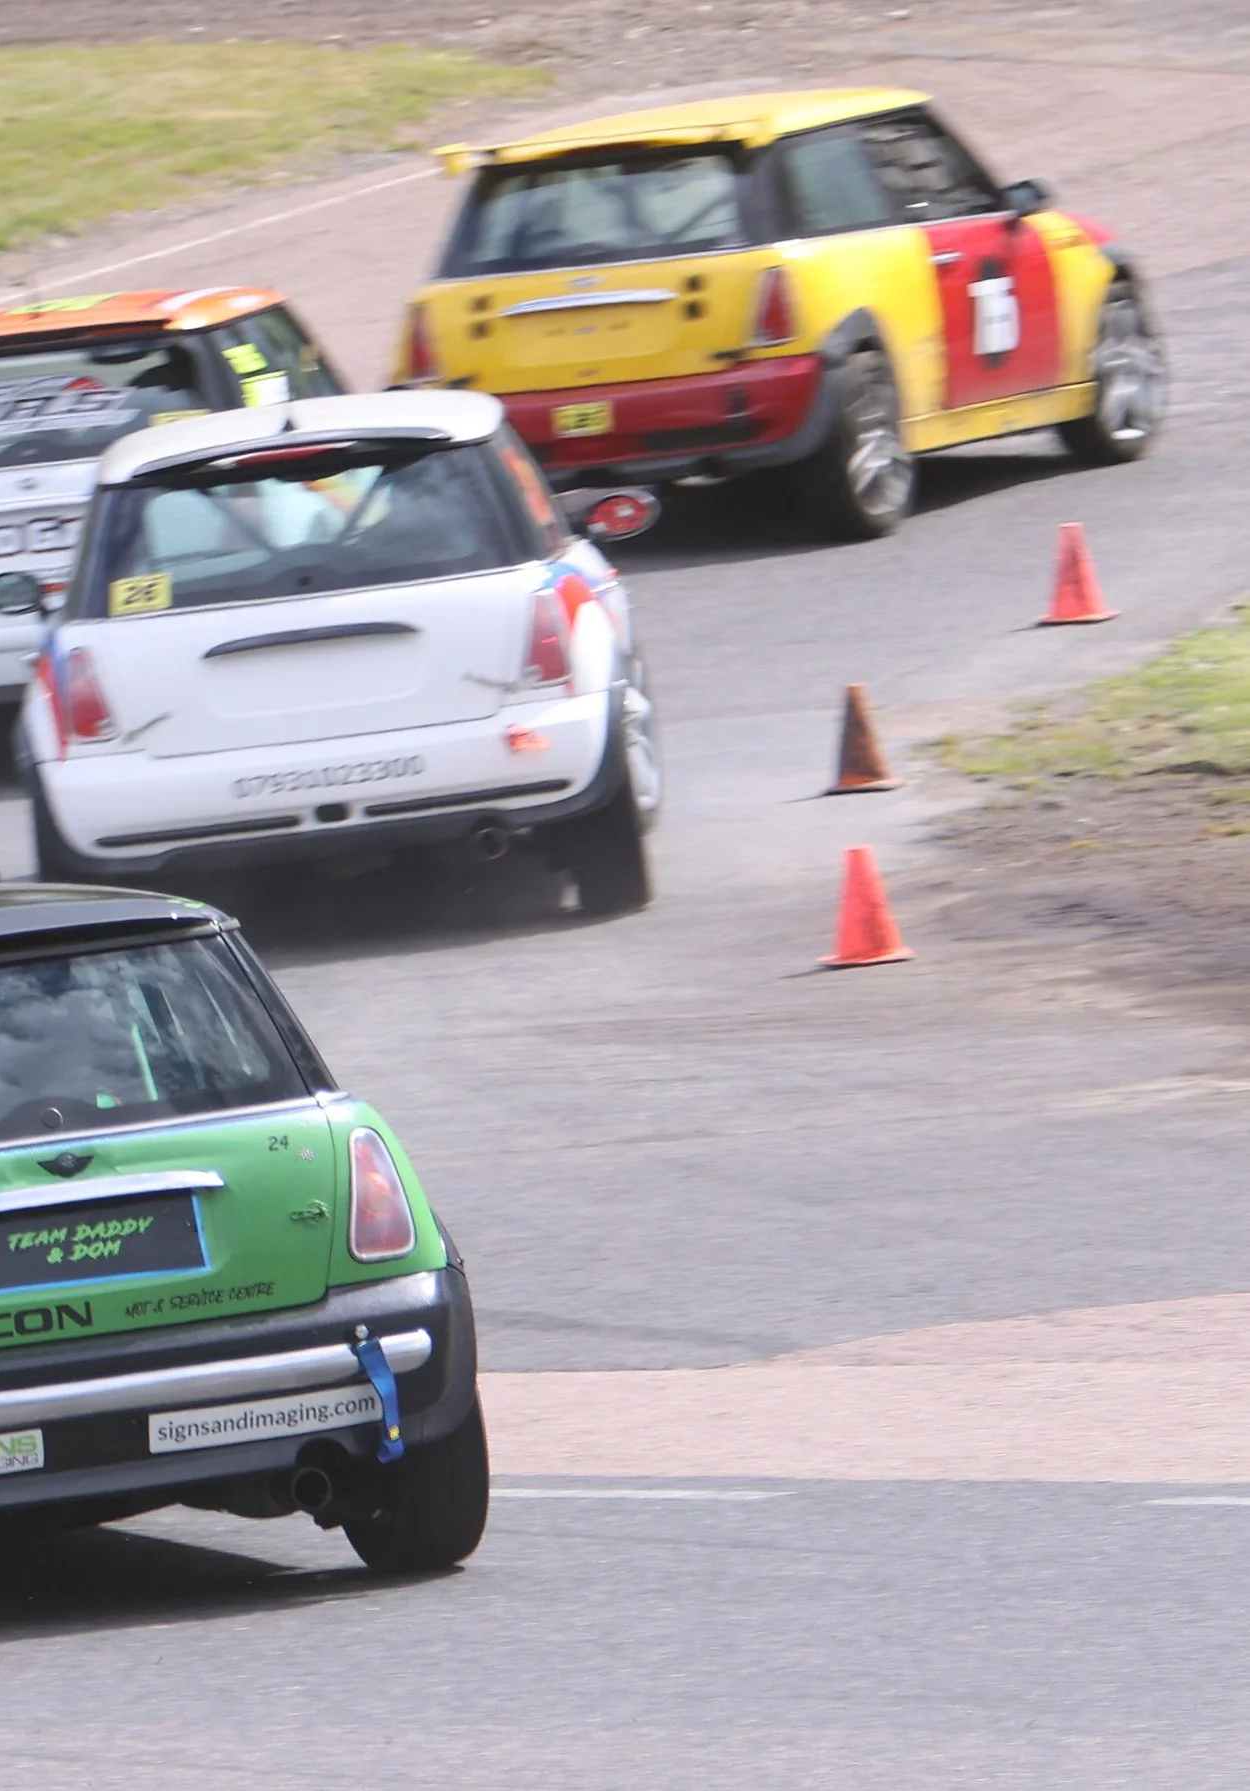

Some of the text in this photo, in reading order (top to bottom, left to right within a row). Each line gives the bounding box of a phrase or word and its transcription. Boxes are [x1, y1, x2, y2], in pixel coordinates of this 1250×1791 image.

[268, 1134, 290, 1152] 24
[7, 1215, 155, 1252] TEAM DADDY
[46, 1239, 122, 1264] & DOM
[169, 1288, 224, 1311] SERVICE
[228, 1281, 276, 1301] CENTRE
[157, 1395, 376, 1444] signsandimaging.com
